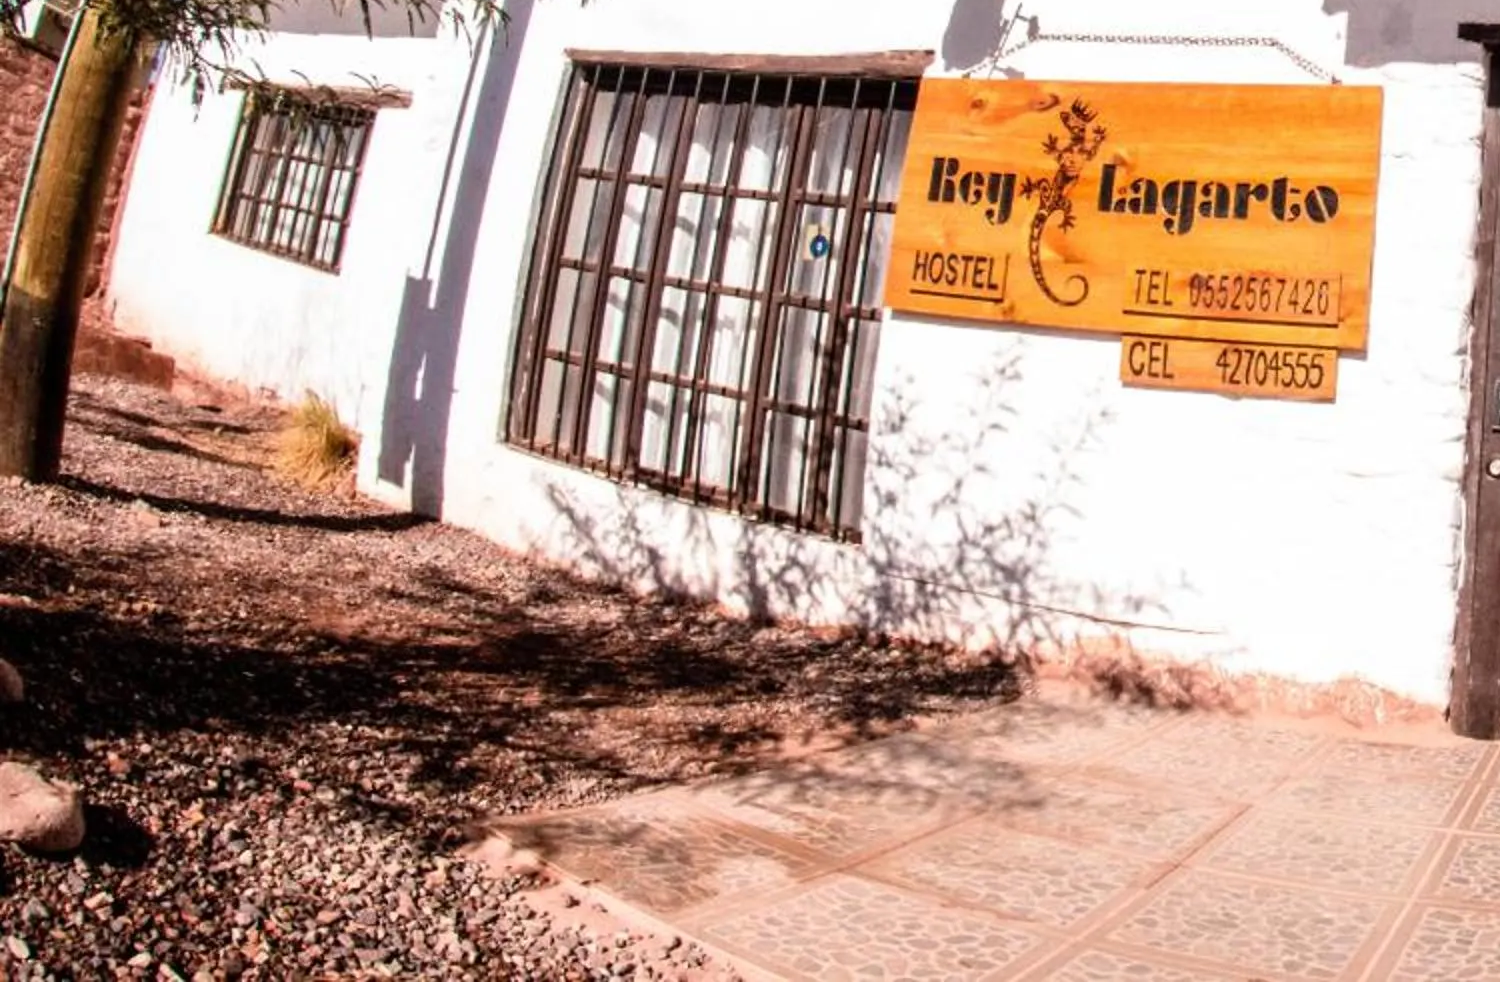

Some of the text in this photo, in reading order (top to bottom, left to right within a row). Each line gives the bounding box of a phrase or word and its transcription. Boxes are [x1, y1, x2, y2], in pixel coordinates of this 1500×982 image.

[927, 157, 1339, 235] Rey Lagarto
[912, 249, 998, 290] HOSTEL
[1134, 269, 1173, 306] TEL
[1129, 340, 1325, 389] CEL 42704555
